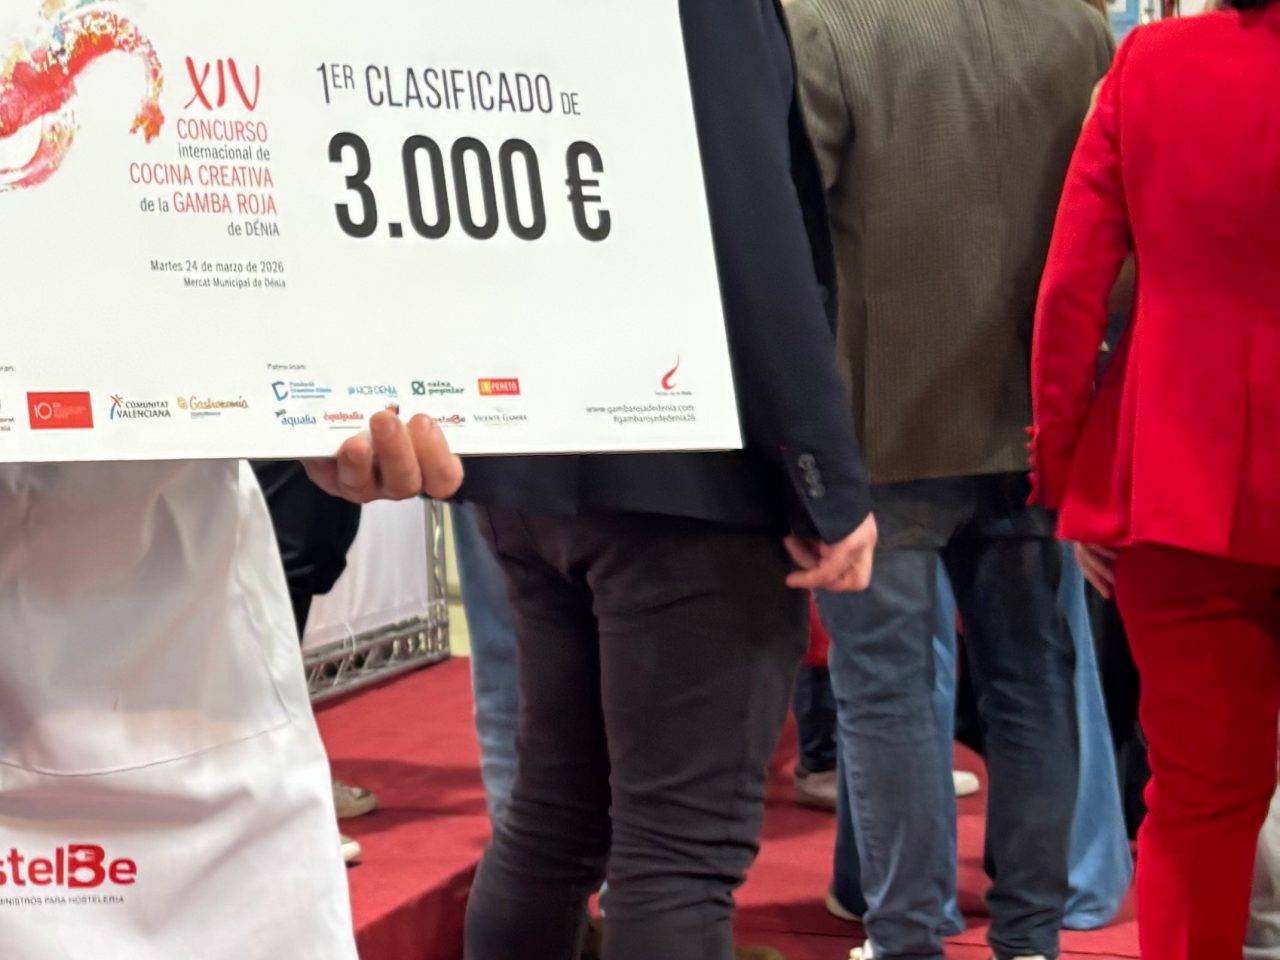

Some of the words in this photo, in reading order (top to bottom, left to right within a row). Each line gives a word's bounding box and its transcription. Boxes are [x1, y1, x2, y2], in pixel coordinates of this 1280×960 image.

[183, 56, 261, 111] XIV
[365, 65, 553, 113] CLASIFICADO
[560, 92, 581, 115] DE
[177, 118, 268, 142] CONCURSO
[178, 142, 252, 161] internacional
[256, 146, 270, 161] de
[129, 162, 193, 185] COCINA
[198, 165, 274, 188] CREATIVA
[328, 131, 547, 240] 3.000
[565, 140, 612, 242] €
[140, 197, 155, 212] de
[158, 197, 169, 212] la
[173, 192, 232, 214] GAMBA
[237, 193, 277, 215] ROJA
[227, 222, 241, 236] de
[245, 218, 280, 236] DÉNIA
[150, 259, 183, 272] Martes
[186, 260, 198, 272] 24
[201, 261, 213, 272] de
[216, 263, 243, 273] marzo
[246, 261, 257, 272] de
[260, 261, 284, 273] 2026
[184, 277, 210, 288] Mercat
[213, 277, 250, 289] Municipal
[117, 409, 171, 419] VALENCIANA
[125, 401, 168, 409] COMUNITAT
[44, 896, 66, 905] PARA
